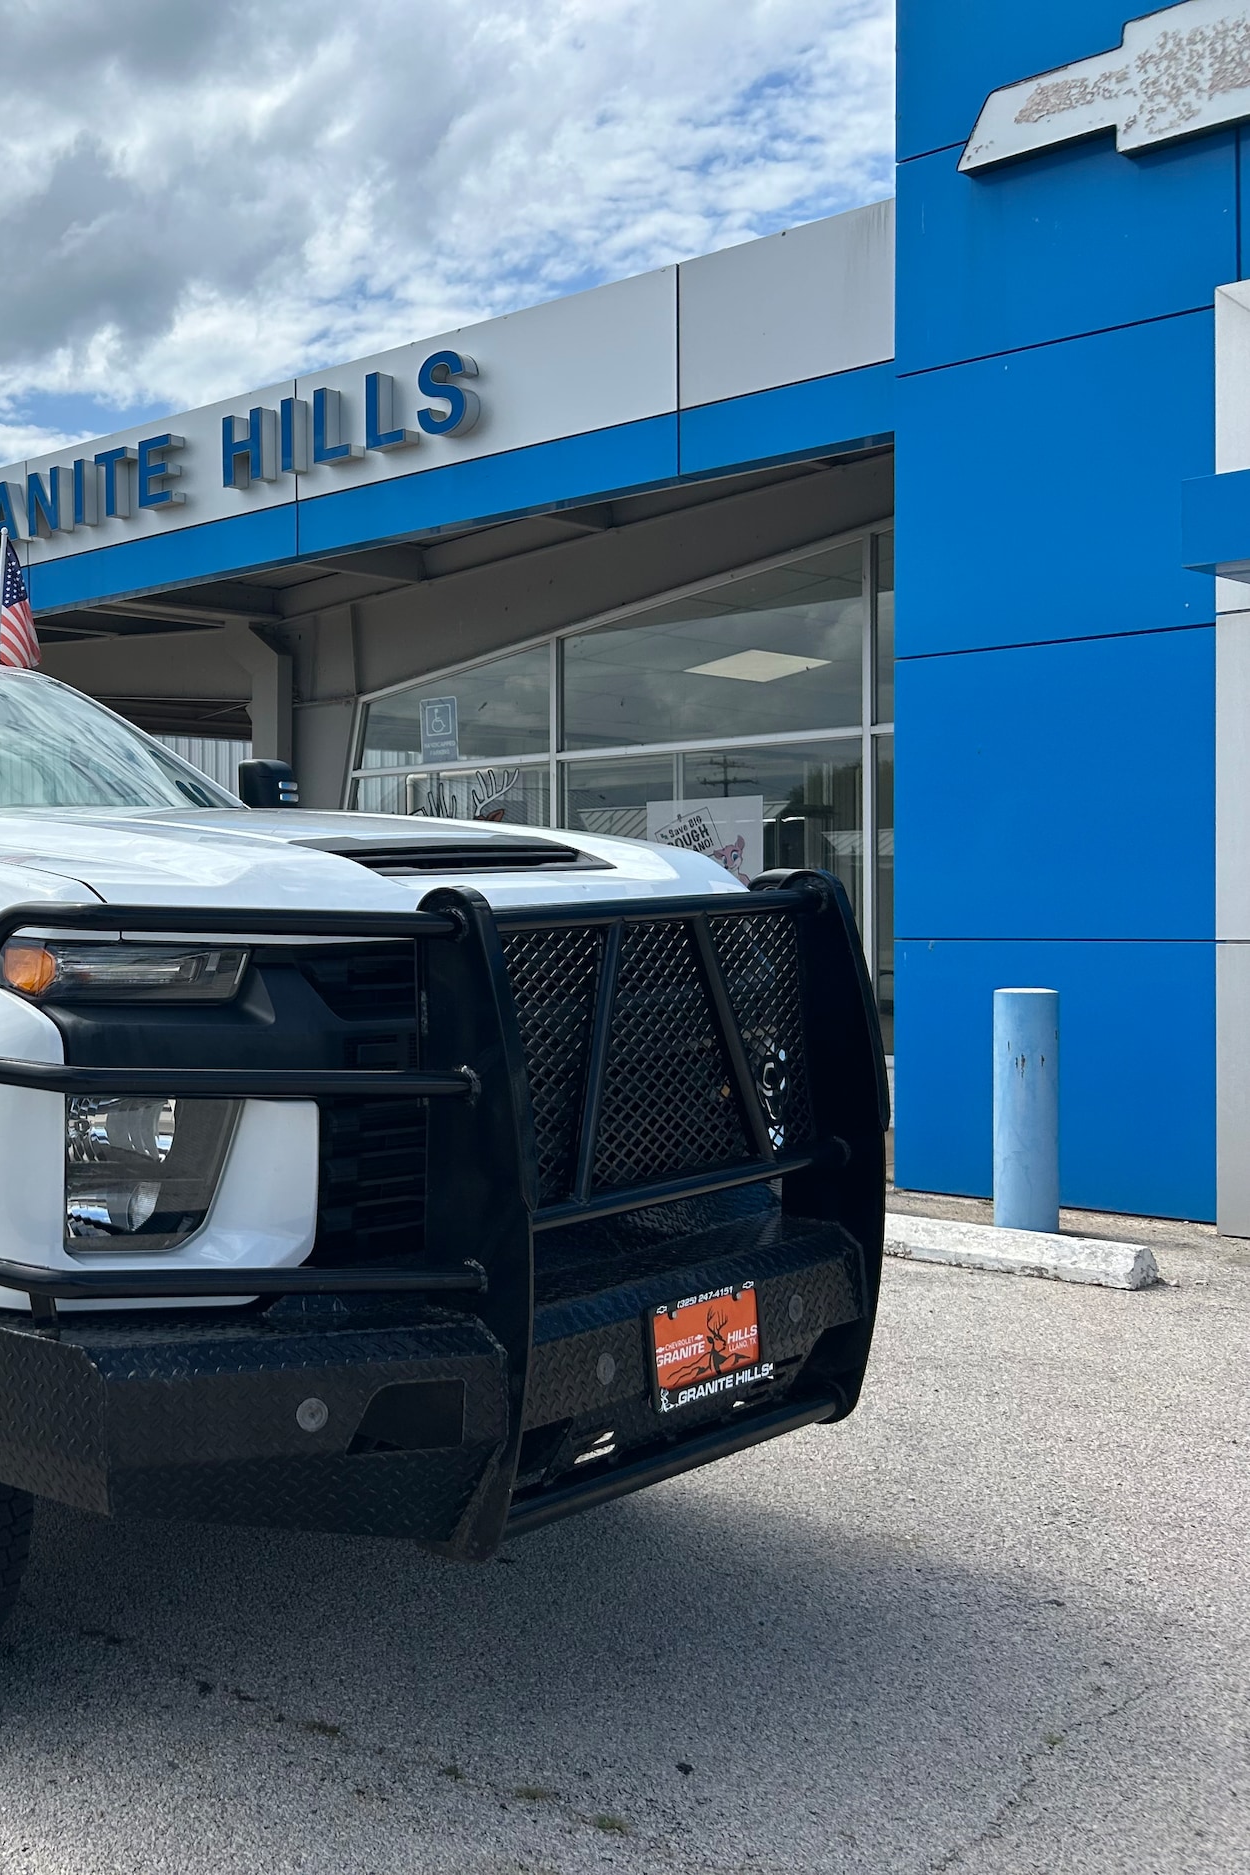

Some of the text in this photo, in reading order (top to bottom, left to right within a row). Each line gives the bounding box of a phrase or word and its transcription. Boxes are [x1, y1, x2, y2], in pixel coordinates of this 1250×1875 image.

[222, 351, 481, 489] HILLS
[668, 826, 688, 838] Save
[664, 1336, 695, 1352] CHEVROLET
[727, 1324, 758, 1344] HILLS
[749, 1337, 757, 1345] TX
[656, 1341, 706, 1368] GRANITE
[678, 1362, 770, 1405] GRANITE HILLS
